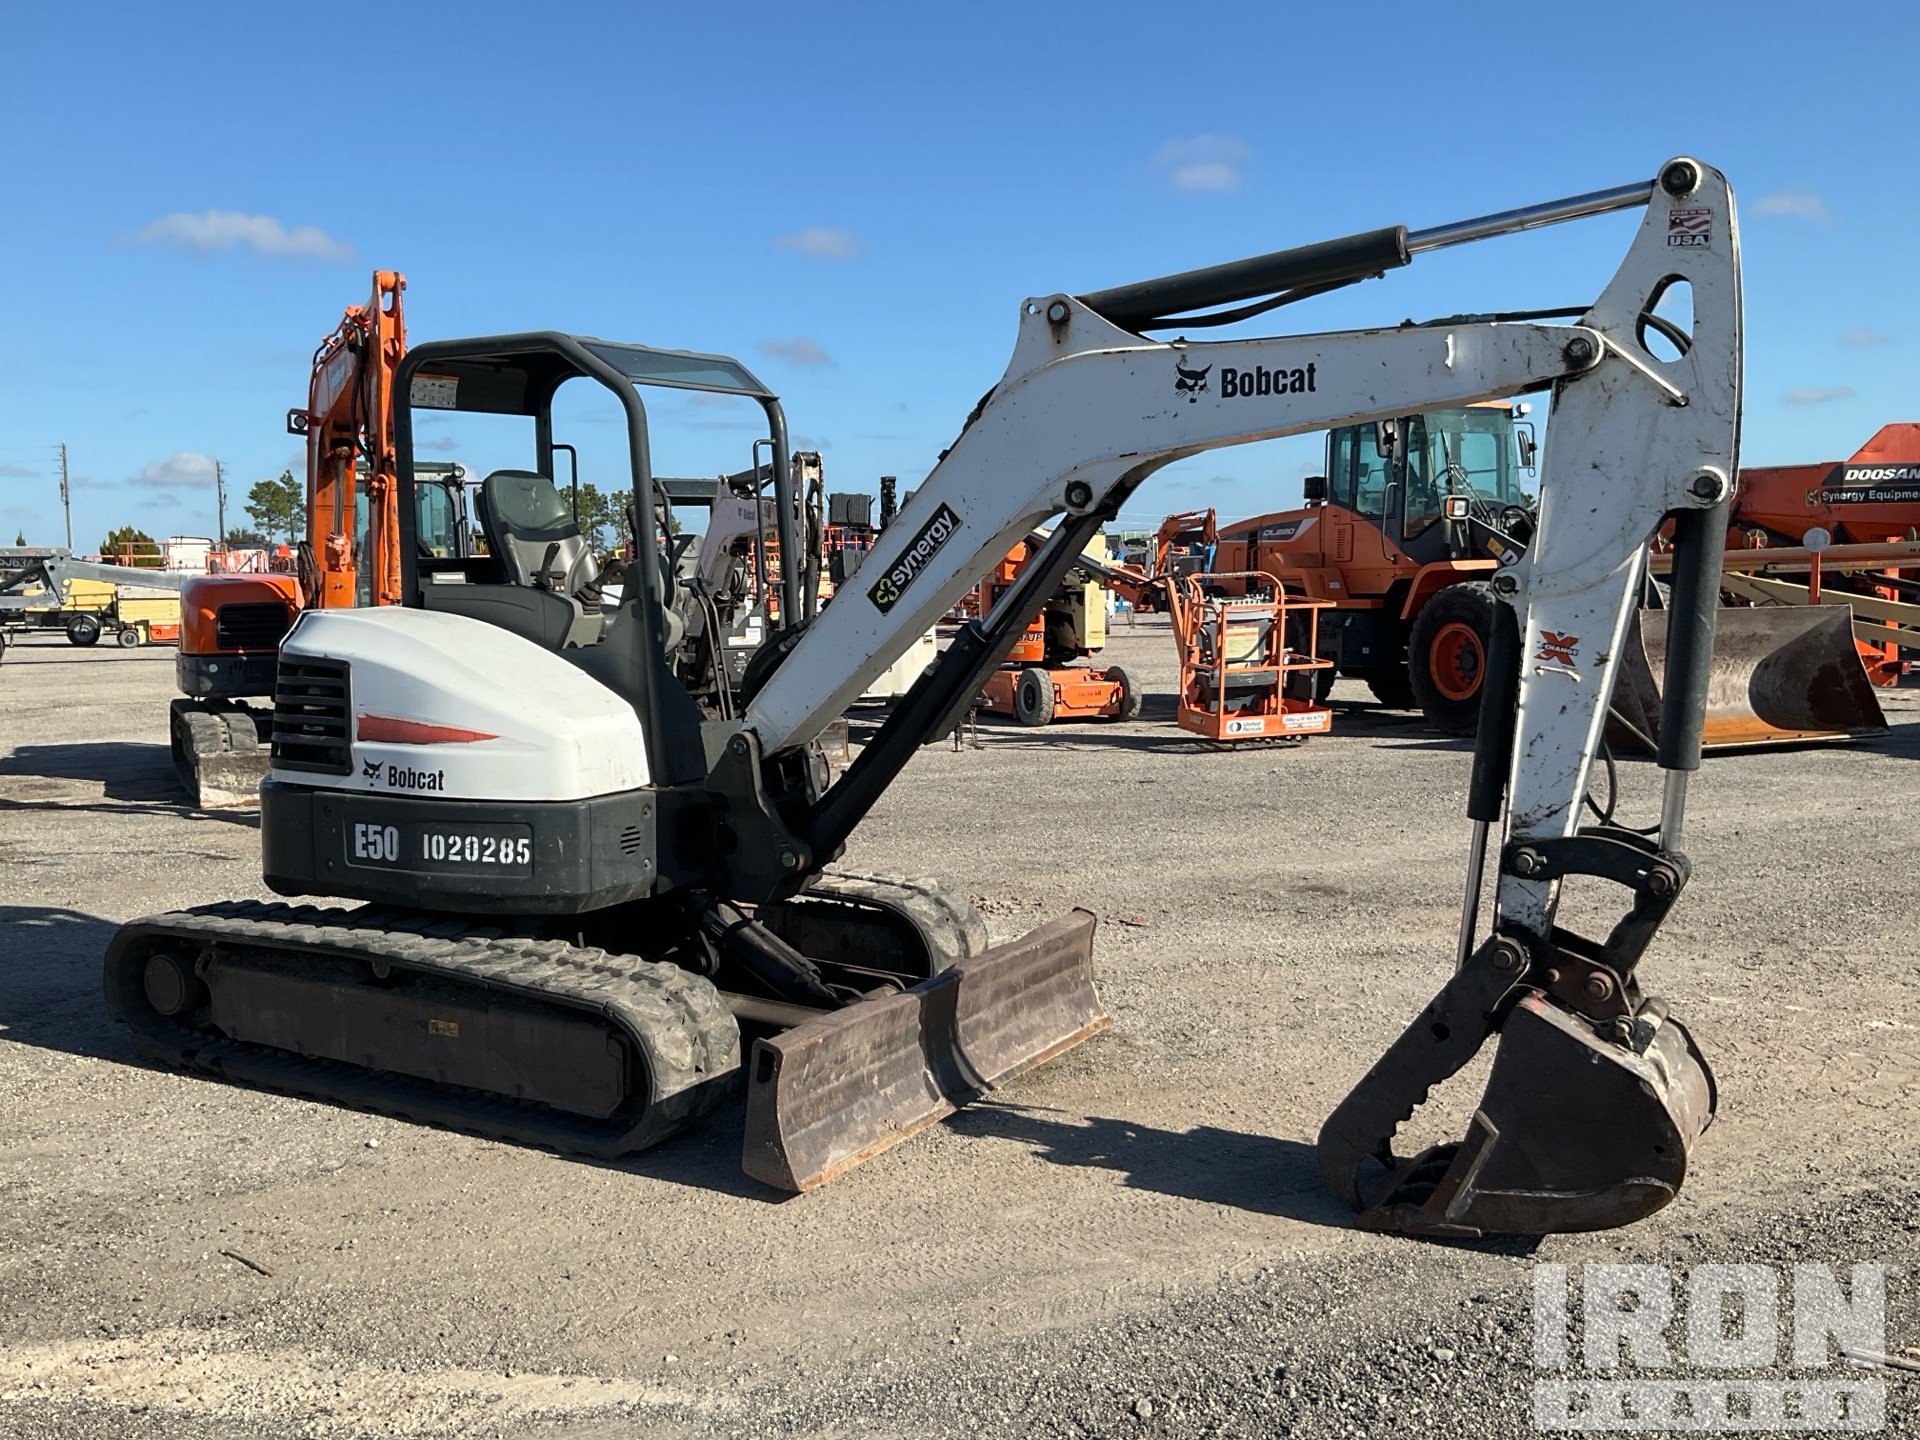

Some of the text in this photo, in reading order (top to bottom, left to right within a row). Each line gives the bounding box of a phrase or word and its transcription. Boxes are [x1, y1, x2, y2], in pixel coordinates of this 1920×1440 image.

[1669, 235, 1706, 246] USA
[1221, 363, 1316, 398] Bobcat
[1844, 468, 1920, 480] DOOSAN
[1822, 490, 1920, 502] Synergy Equipme
[891, 510, 953, 586] synergy
[388, 756, 444, 791] Bobcat
[355, 823, 399, 862] E50
